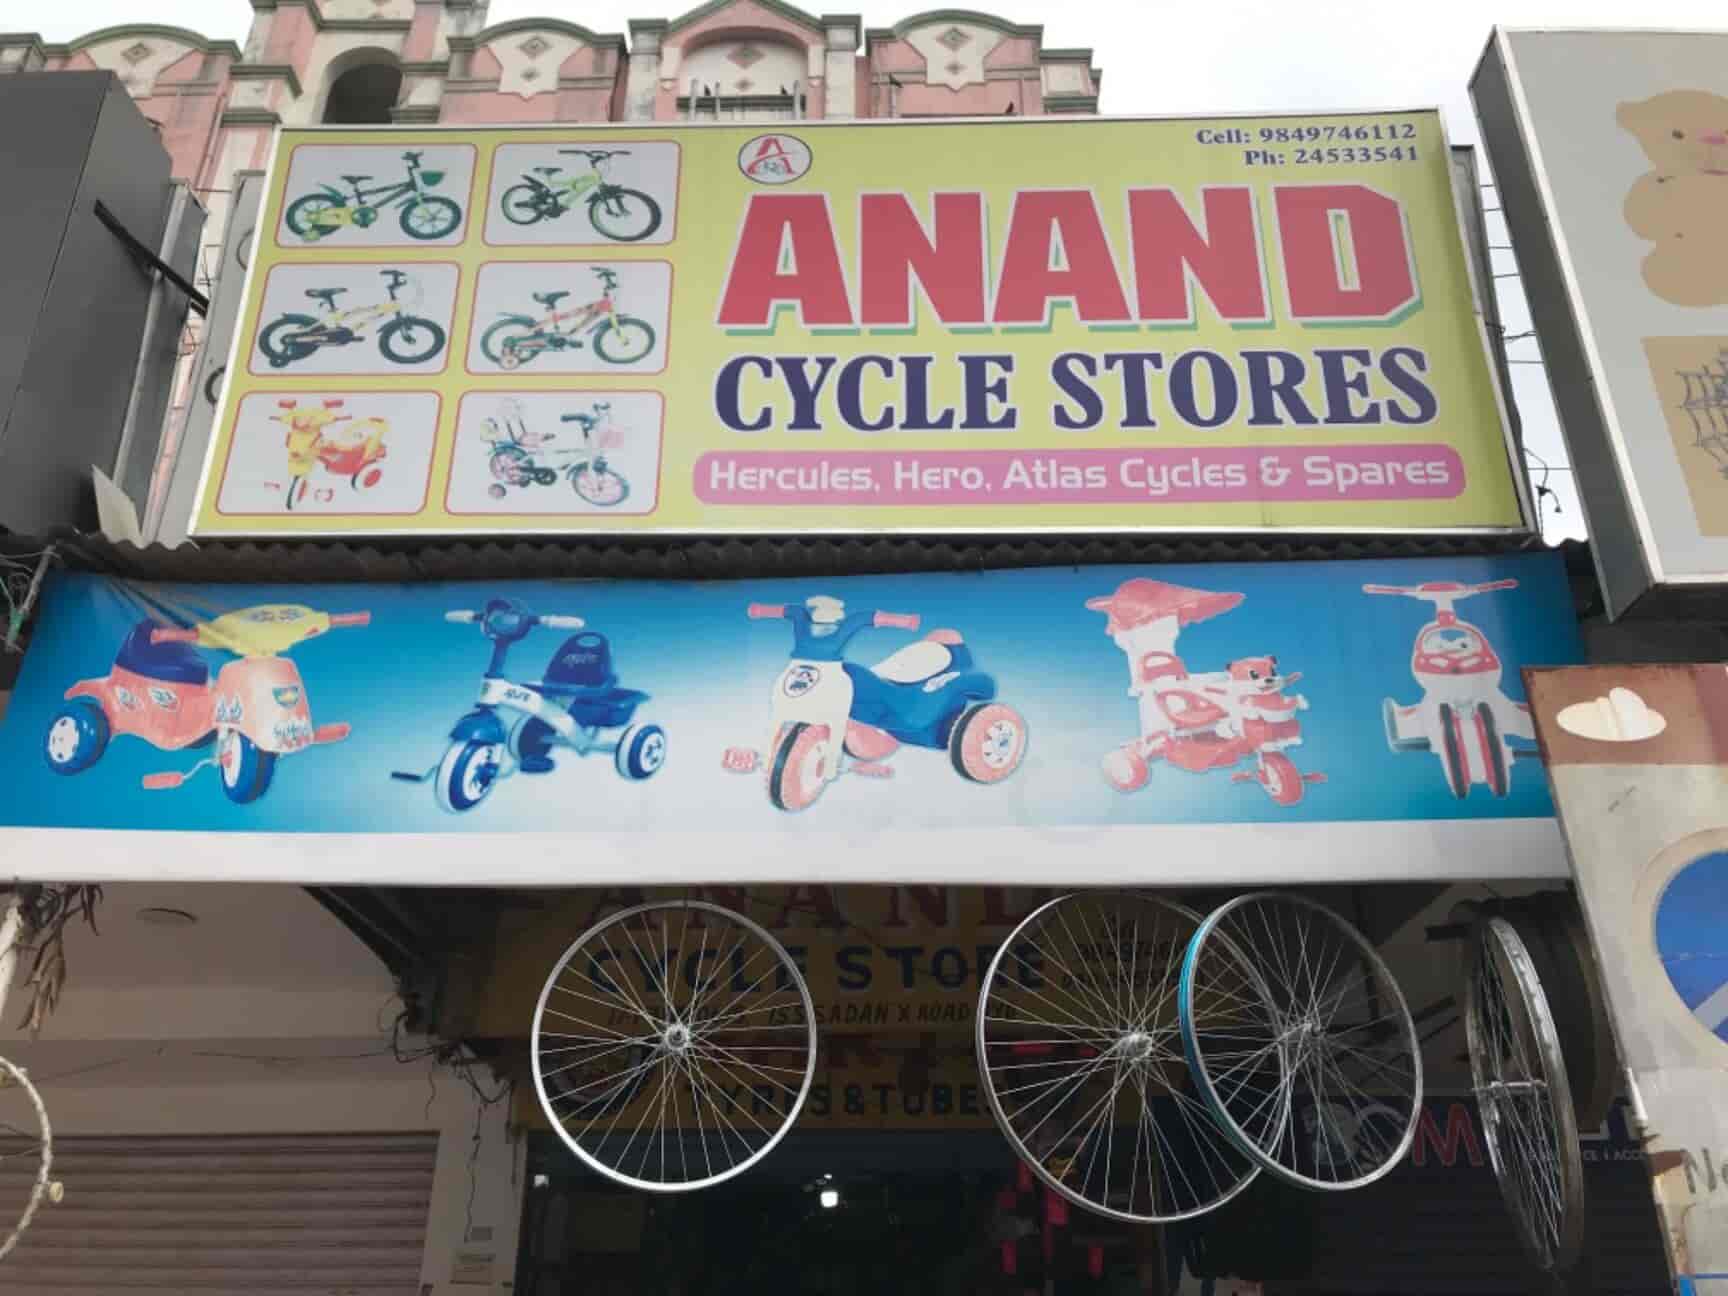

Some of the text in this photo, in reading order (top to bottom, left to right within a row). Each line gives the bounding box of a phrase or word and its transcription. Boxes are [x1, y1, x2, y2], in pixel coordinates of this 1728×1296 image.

[1196, 123, 1417, 144] Cell: 9849746112
[1244, 145, 1418, 166] Ph: 24533541
[716, 184, 1423, 334] ANAND
[714, 347, 1437, 431] CYCLE STORES
[1003, 459, 1107, 490] Atlas
[1119, 457, 1248, 497] Cycles
[1259, 456, 1292, 487] &
[1303, 455, 1450, 494] Spares
